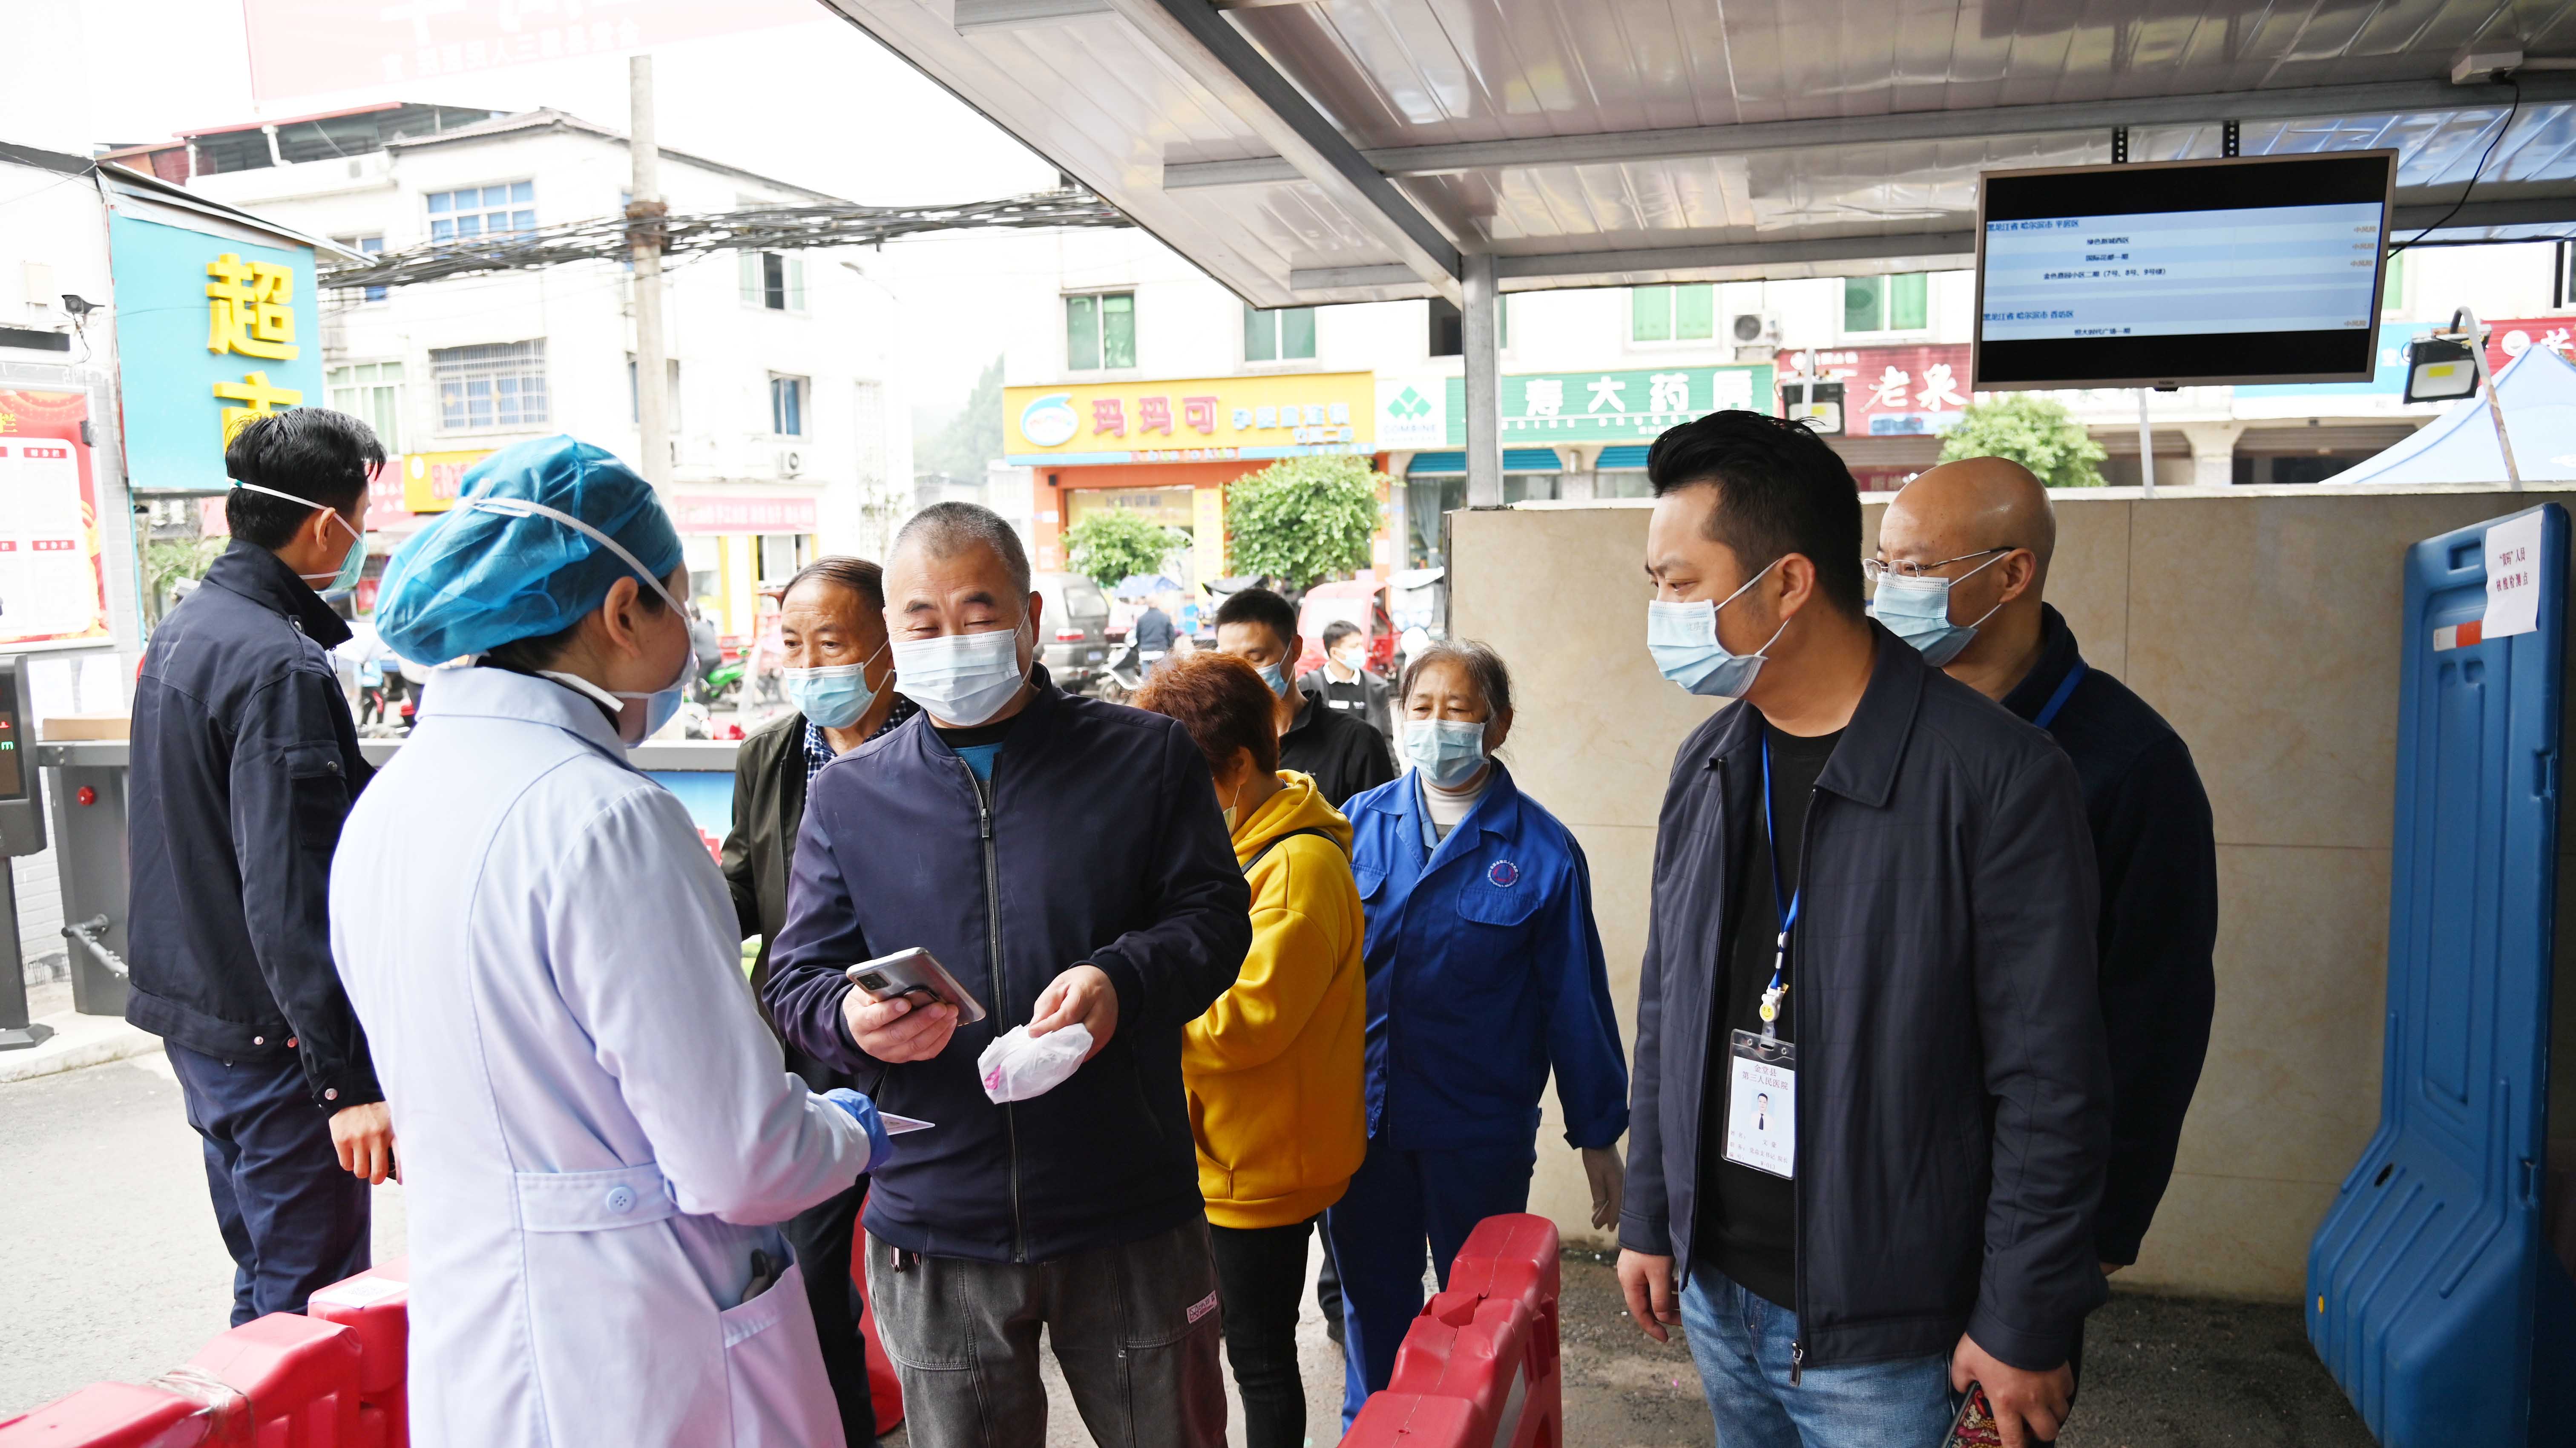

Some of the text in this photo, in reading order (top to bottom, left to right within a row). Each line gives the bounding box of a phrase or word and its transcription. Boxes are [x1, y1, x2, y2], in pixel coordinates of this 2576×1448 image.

[1092, 396, 1219, 437] 玛玛可
[2496, 571, 2528, 592] 核酸检测点
[1742, 1071, 1788, 1090] 第三人民医院
[1754, 1064, 1777, 1077] 金堂县
